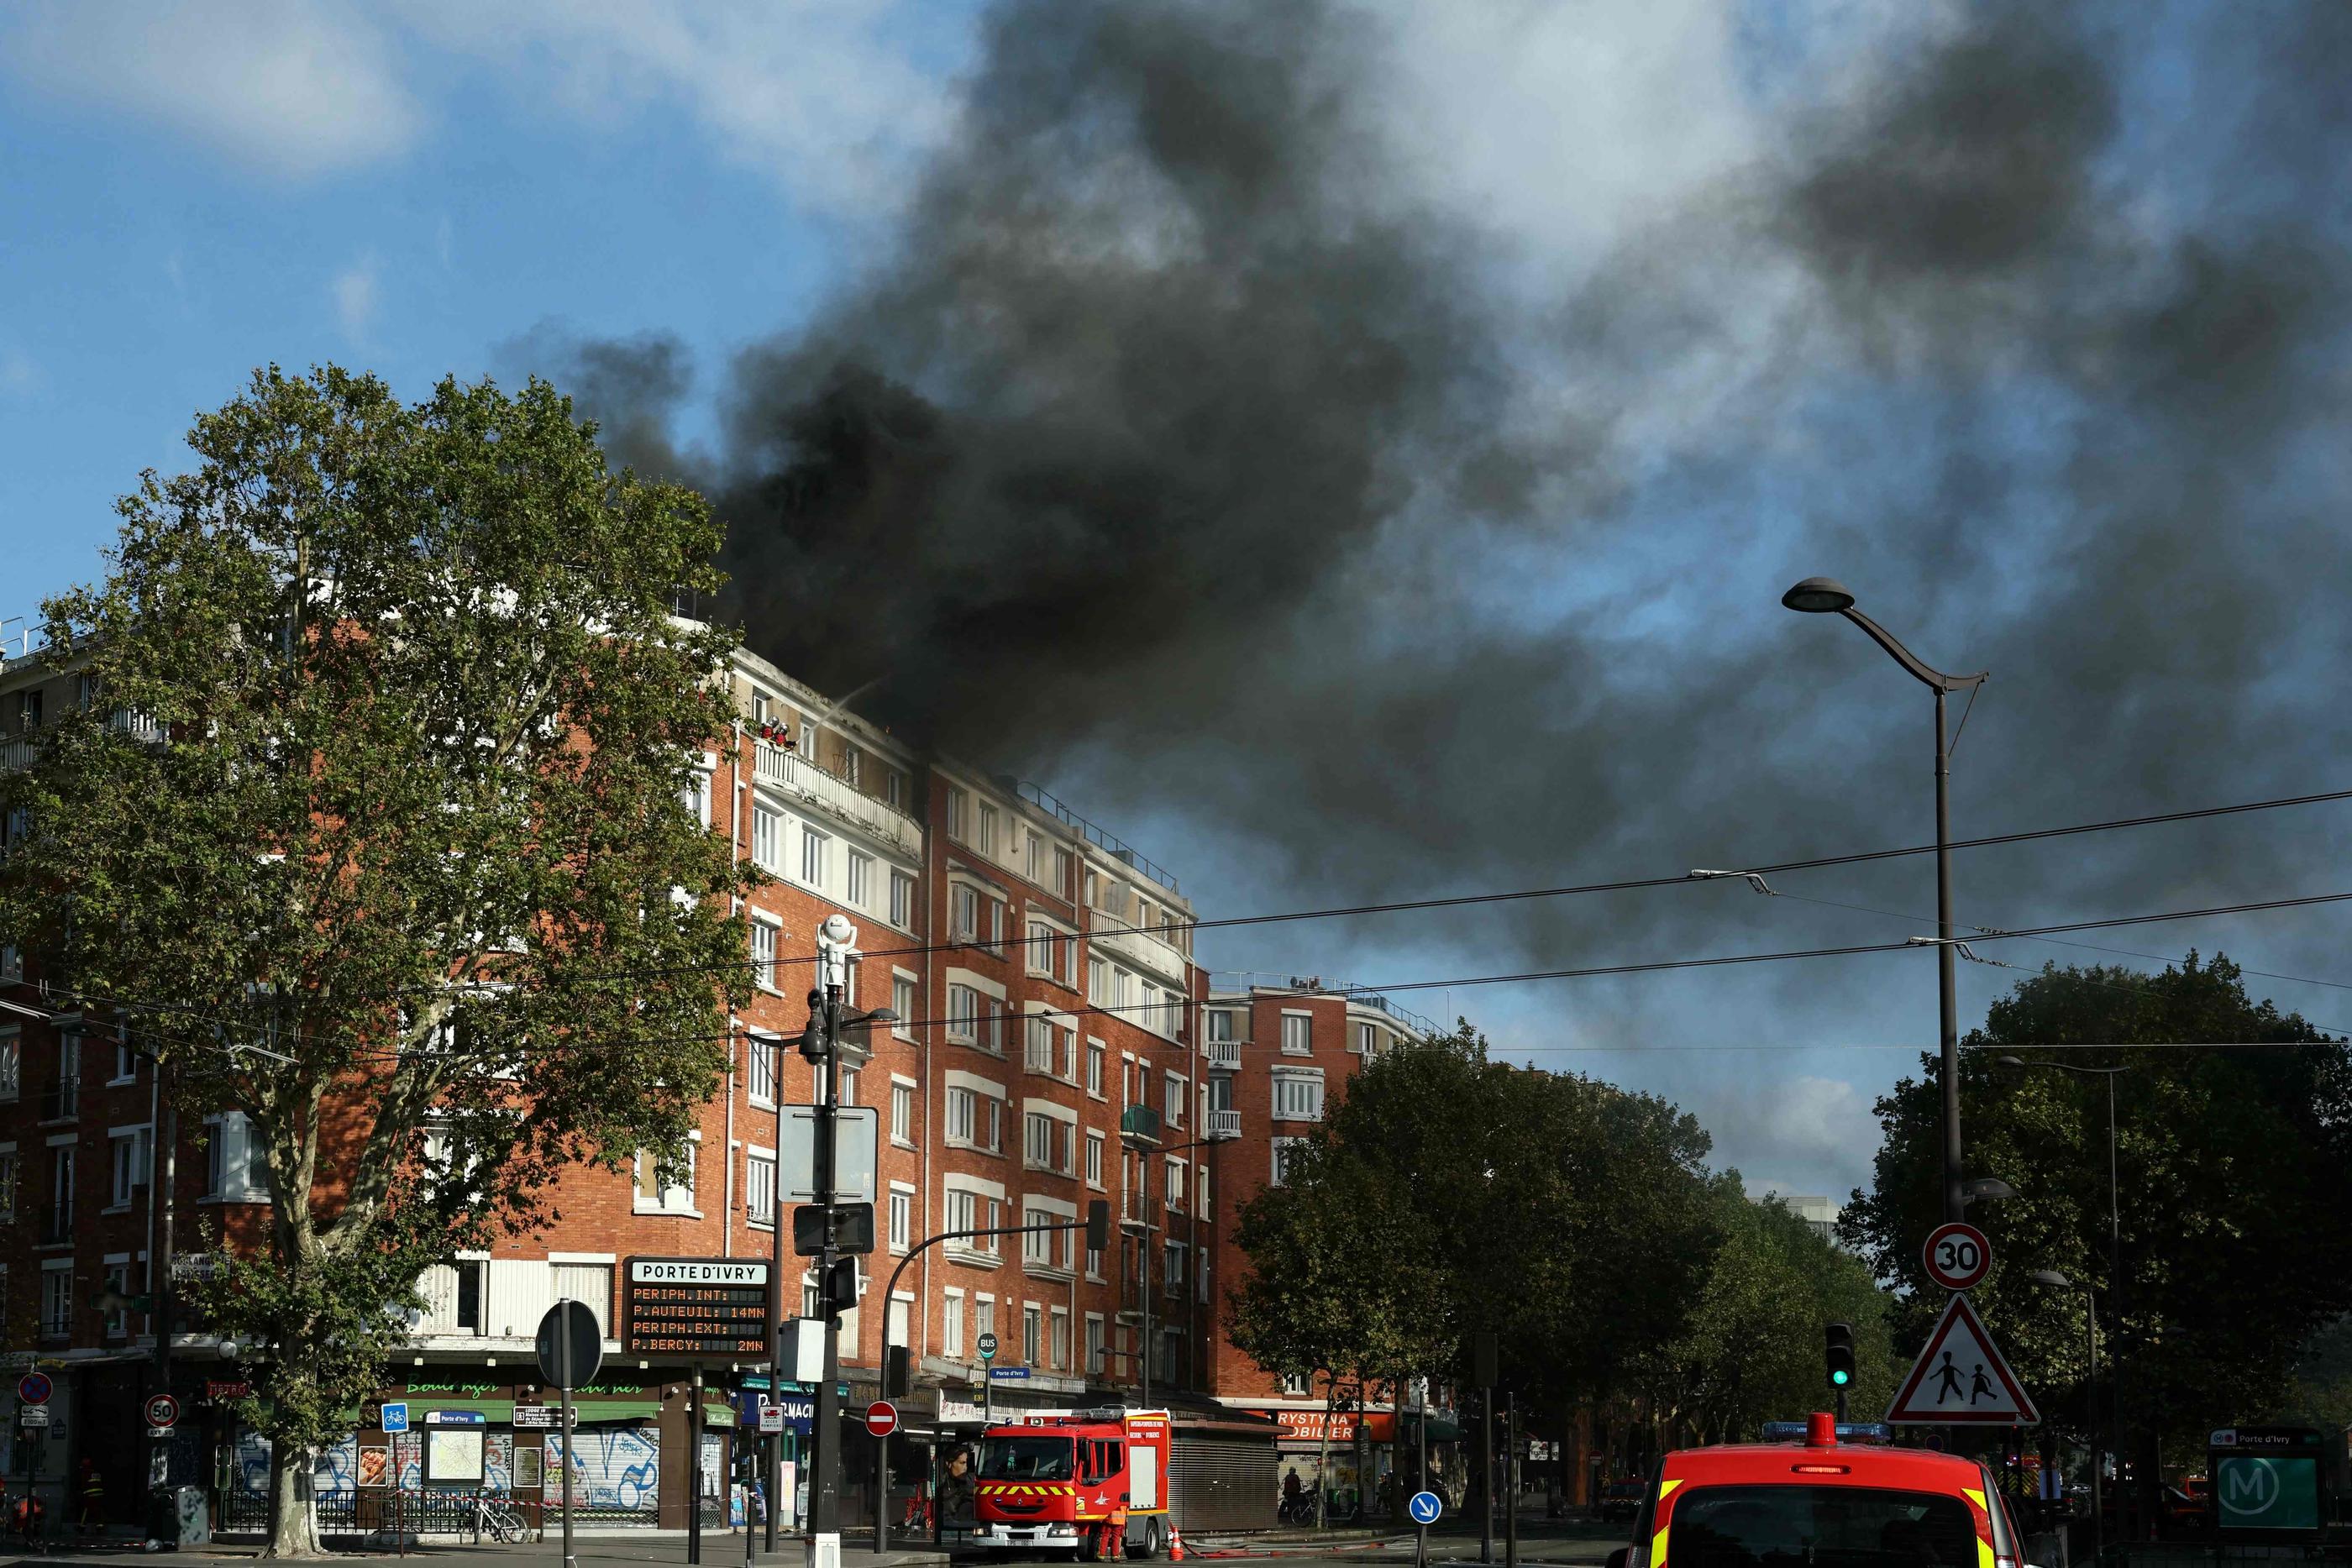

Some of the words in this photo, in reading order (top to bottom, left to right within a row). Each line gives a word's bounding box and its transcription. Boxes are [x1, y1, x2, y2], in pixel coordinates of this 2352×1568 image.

[1937, 1241, 1978, 1271] 30
[643, 1265, 697, 1279] PORTE
[702, 1266, 755, 1280] D'IVRY
[633, 1288, 728, 1301] PERIPH.INT:
[633, 1305, 720, 1318] P.AUTEUIL:
[731, 1307, 765, 1319] 14MN
[633, 1322, 728, 1335] PERIPH.EXT:
[632, 1339, 701, 1350] P.BERCY:
[738, 1340, 764, 1351] 2MN
[980, 1339, 995, 1347] BUS
[153, 1404, 171, 1418] 50
[758, 1393, 814, 1420] PRMACI
[454, 1415, 469, 1424] d'Ivry
[1278, 1413, 1348, 1425] RYSTYNA
[1279, 1427, 1352, 1439] OBILER
[2264, 1434, 2291, 1445] d'Ivry
